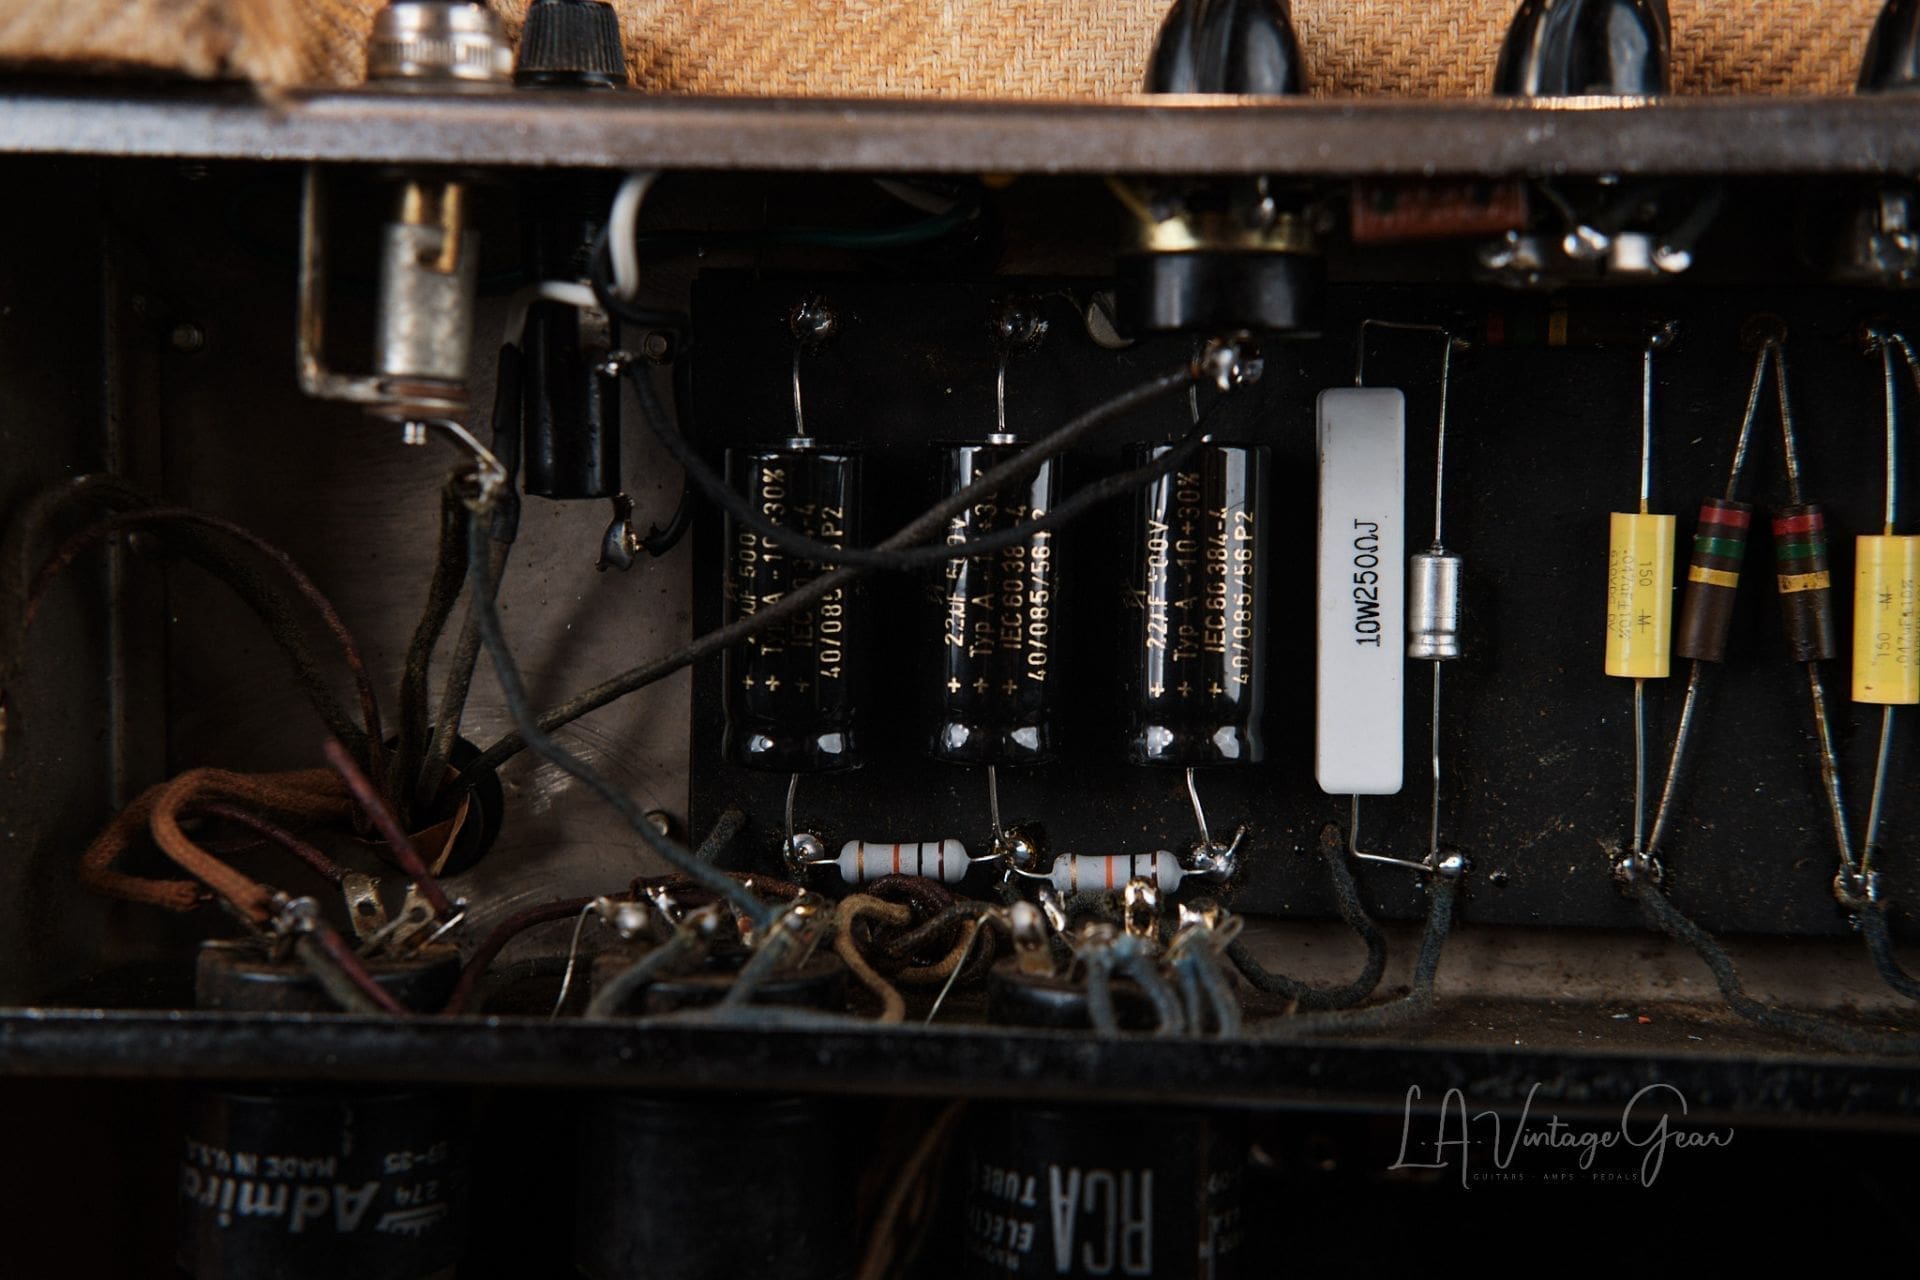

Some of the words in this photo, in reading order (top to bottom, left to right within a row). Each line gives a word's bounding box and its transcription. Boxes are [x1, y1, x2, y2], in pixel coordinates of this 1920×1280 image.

[821, 506, 844, 537] P2
[1003, 503, 1028, 572] 38-4
[1233, 511, 1254, 540] P2
[739, 523, 757, 578] 500
[1353, 518, 1381, 647] 10W250ΩJ
[1639, 561, 1653, 587] 150
[971, 593, 995, 610] A
[1003, 579, 1025, 607] 60
[1173, 595, 1199, 611] A
[1205, 582, 1227, 610] 60
[1001, 612, 1023, 650] IEC
[1028, 545, 1051, 681] 40/085/56
[1232, 548, 1253, 684] 40/085/56
[968, 622, 995, 658] Typ
[1172, 625, 1199, 662] Typ
[1204, 616, 1226, 653] IEC
[234, 1152, 258, 1176] IN
[262, 1153, 337, 1179] MADE
[1048, 1165, 1154, 1276] RCA
